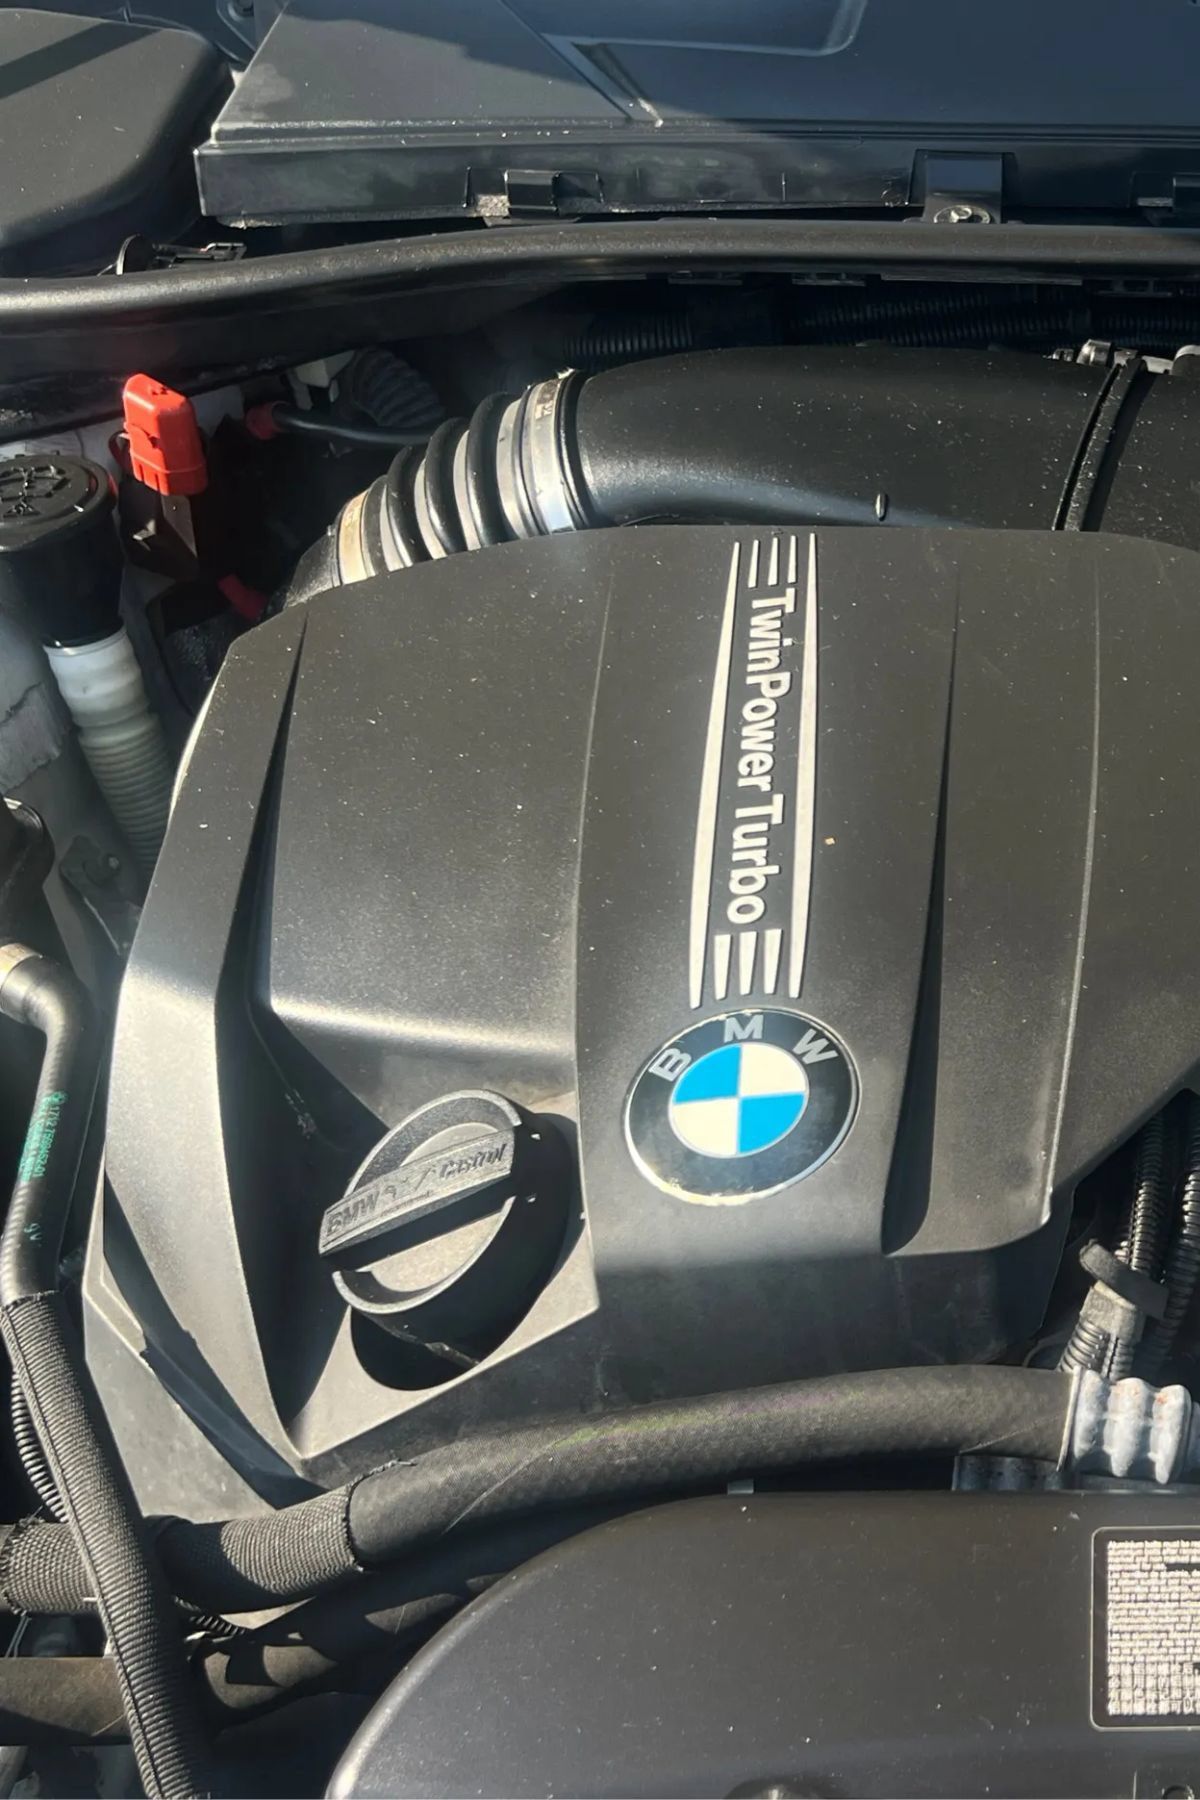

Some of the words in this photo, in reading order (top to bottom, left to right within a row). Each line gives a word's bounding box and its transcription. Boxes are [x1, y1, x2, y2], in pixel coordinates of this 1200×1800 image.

[736, 587, 796, 788] TwinPower
[726, 793, 785, 925] Turbo
[648, 1014, 839, 1083] BMW
[326, 1189, 380, 1236] BMW
